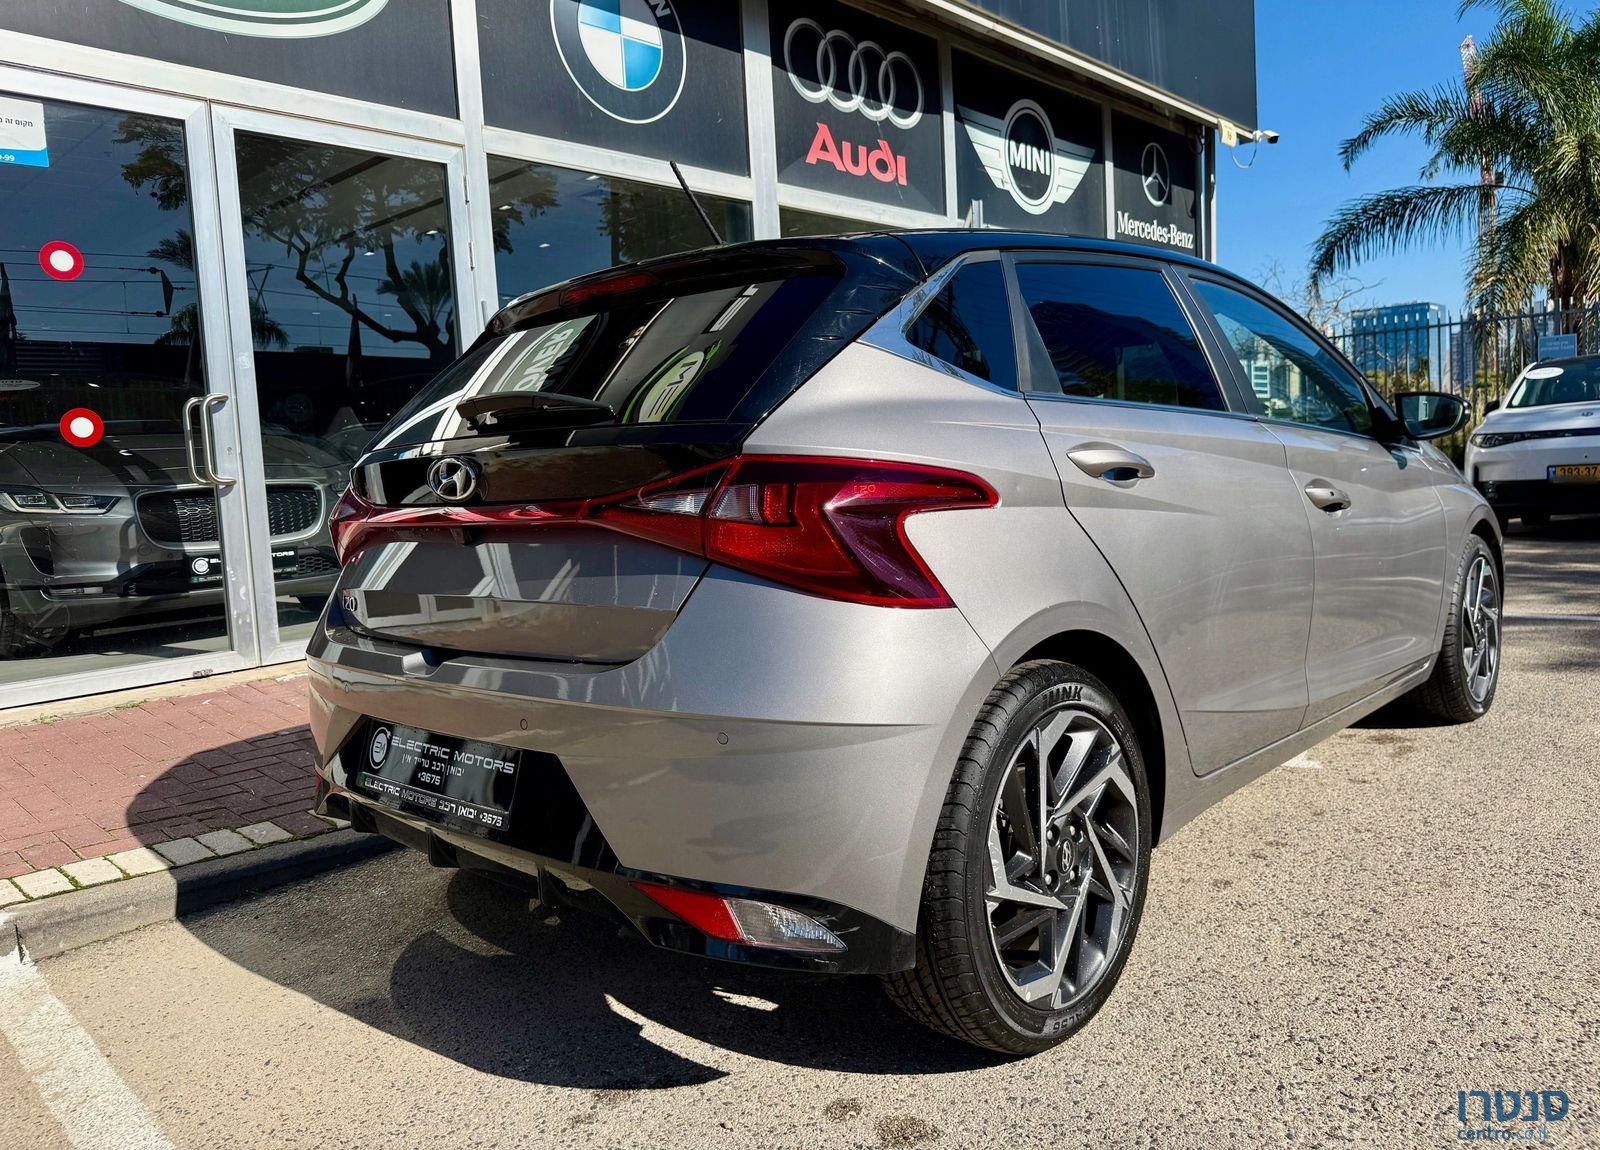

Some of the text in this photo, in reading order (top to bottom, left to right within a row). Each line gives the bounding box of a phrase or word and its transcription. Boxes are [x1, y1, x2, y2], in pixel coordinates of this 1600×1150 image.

[805, 122, 908, 186] Audi
[1009, 140, 1050, 176] MINI
[1117, 210, 1194, 250] Mercedes-Benz
[453, 750, 515, 774] MOTORS
[401, 788, 437, 808] MOTORS
